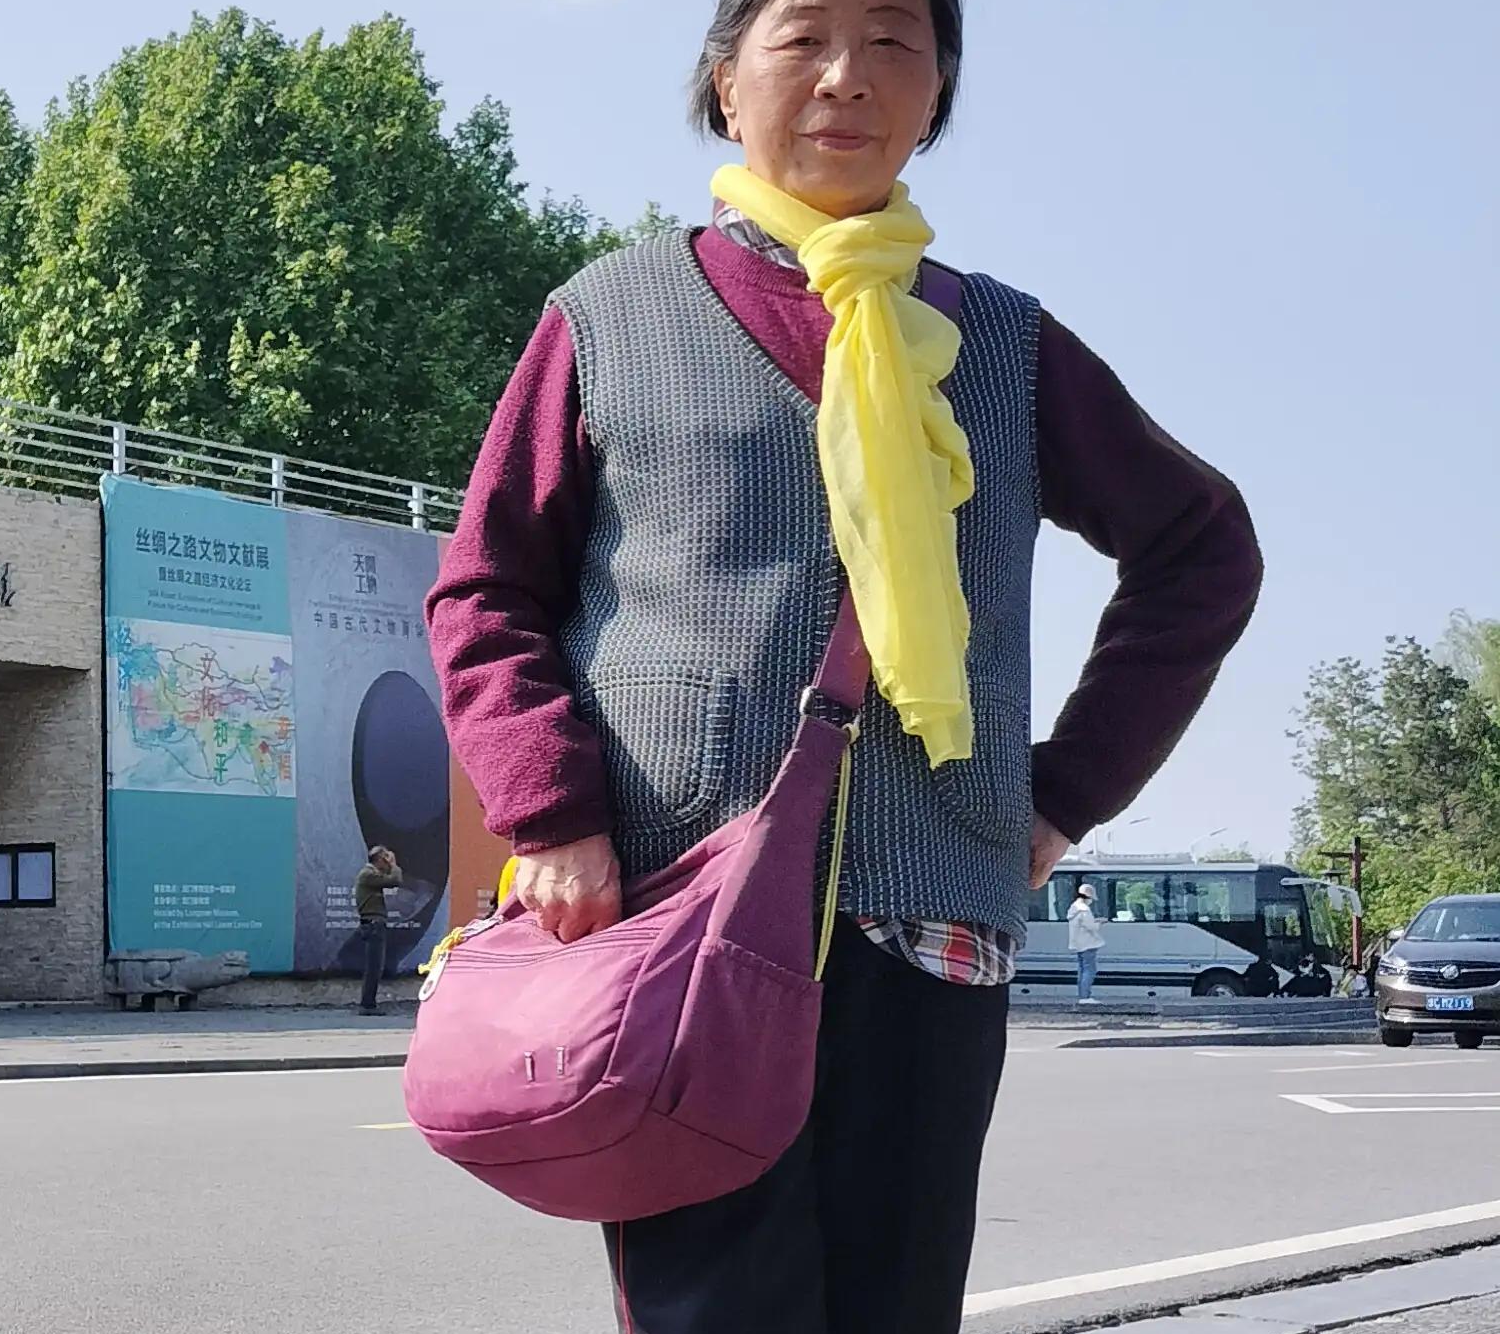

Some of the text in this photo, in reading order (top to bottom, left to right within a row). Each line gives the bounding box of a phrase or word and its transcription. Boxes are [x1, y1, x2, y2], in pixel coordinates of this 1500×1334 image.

[135, 526, 270, 571] 丝绸之路文物文献展
